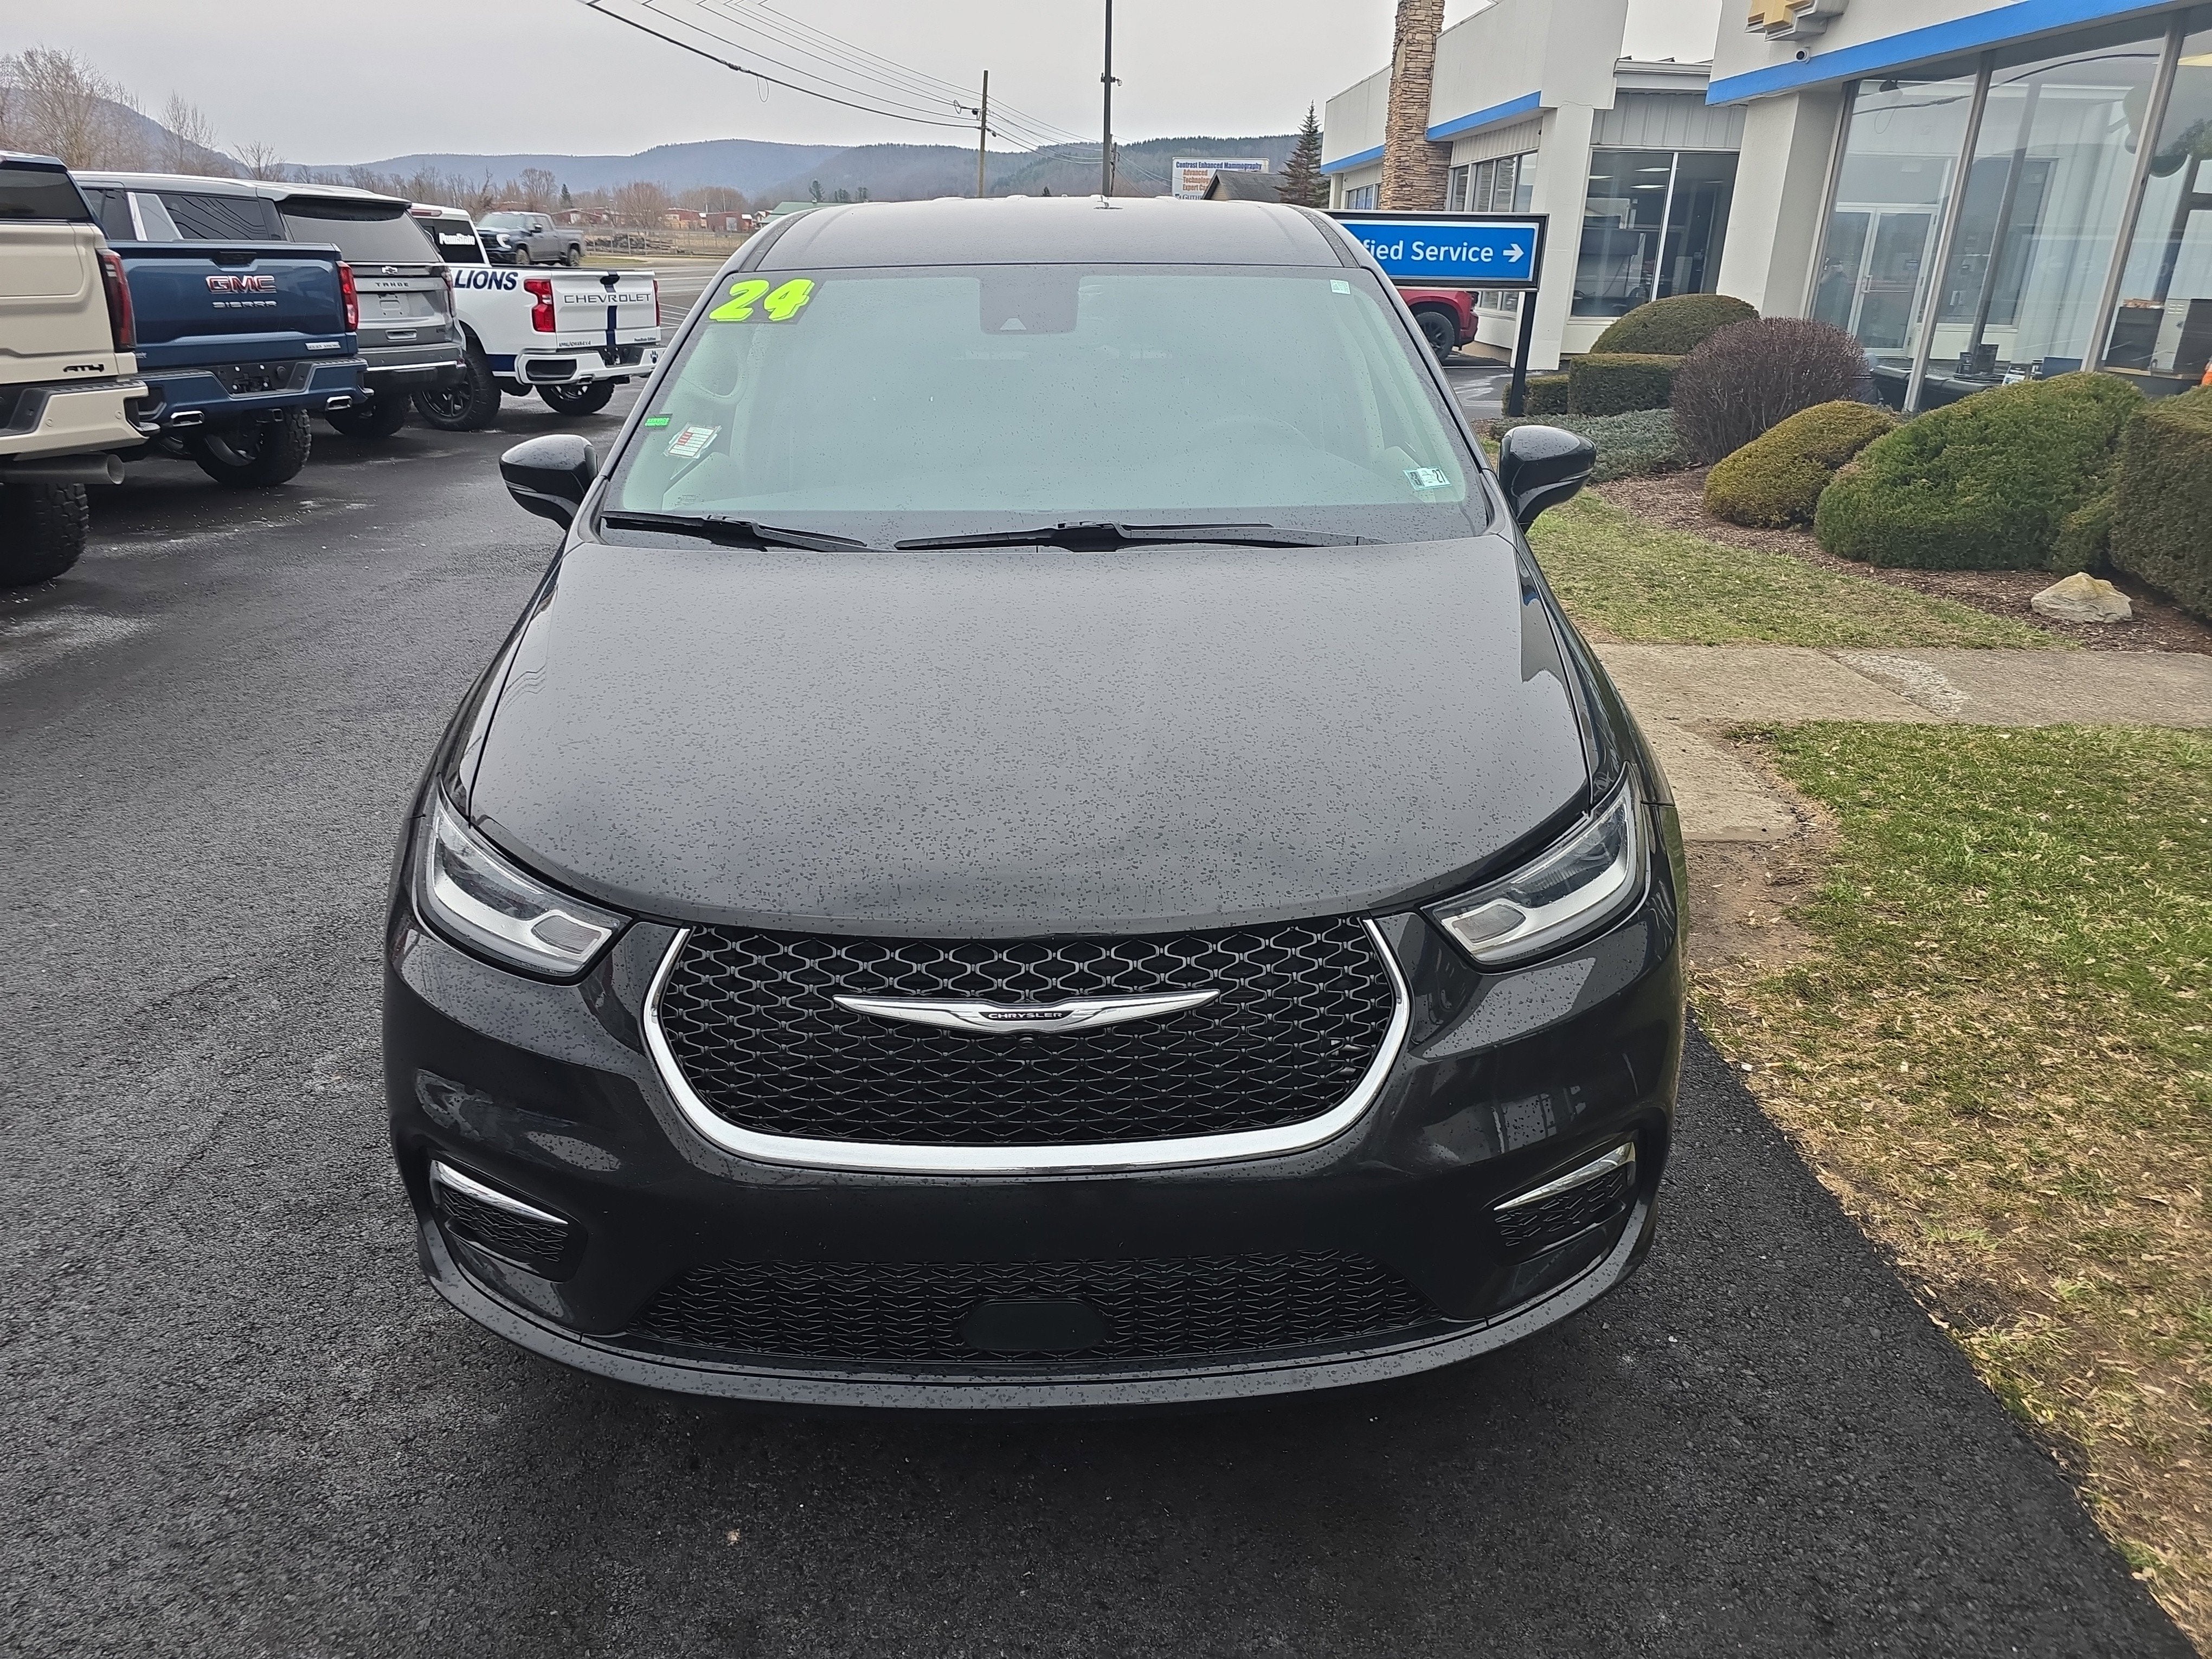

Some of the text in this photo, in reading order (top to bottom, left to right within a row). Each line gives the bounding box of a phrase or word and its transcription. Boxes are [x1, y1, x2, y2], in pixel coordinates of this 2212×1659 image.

[1411, 241, 1494, 262] Service
[205, 275, 278, 294] GMC
[454, 269, 518, 291] LIONS
[564, 293, 651, 304] CHEVROLET
[709, 279, 815, 321] 24
